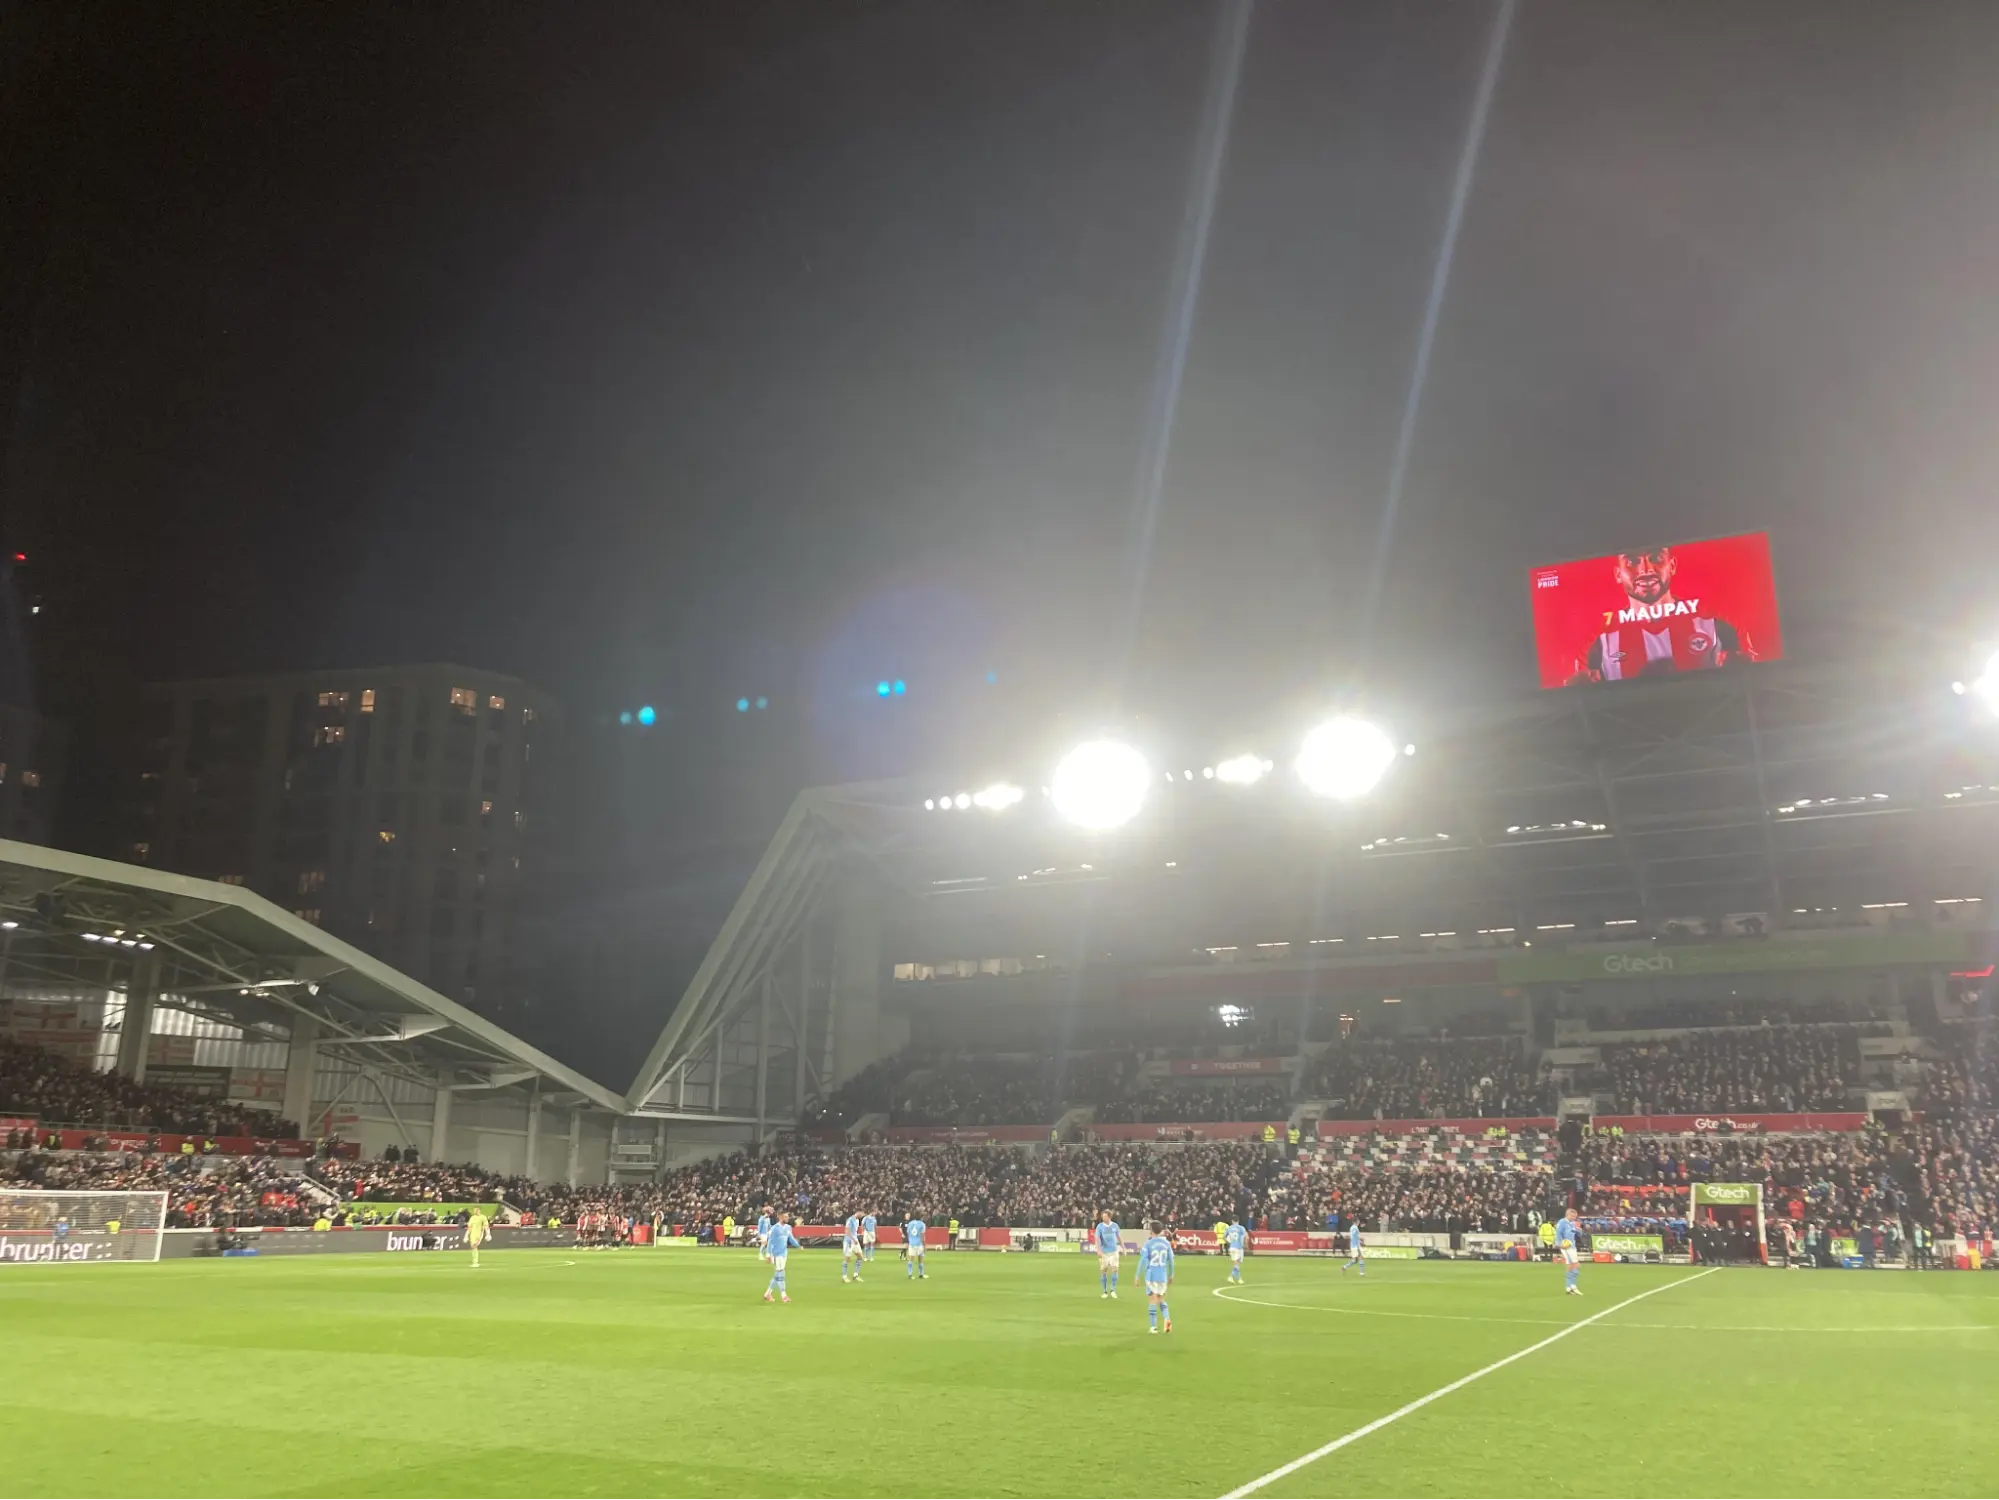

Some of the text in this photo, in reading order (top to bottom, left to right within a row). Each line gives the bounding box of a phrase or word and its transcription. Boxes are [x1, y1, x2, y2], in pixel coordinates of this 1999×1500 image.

[1537, 579, 1559, 588] PRIDE
[1603, 599, 1699, 626] 7 MAUPAY
[1603, 953, 1673, 972] Gtech
[1706, 1186, 1750, 1199] Gtech
[386, 1231, 448, 1251] bruner
[1150, 1249, 1167, 1266] 20
